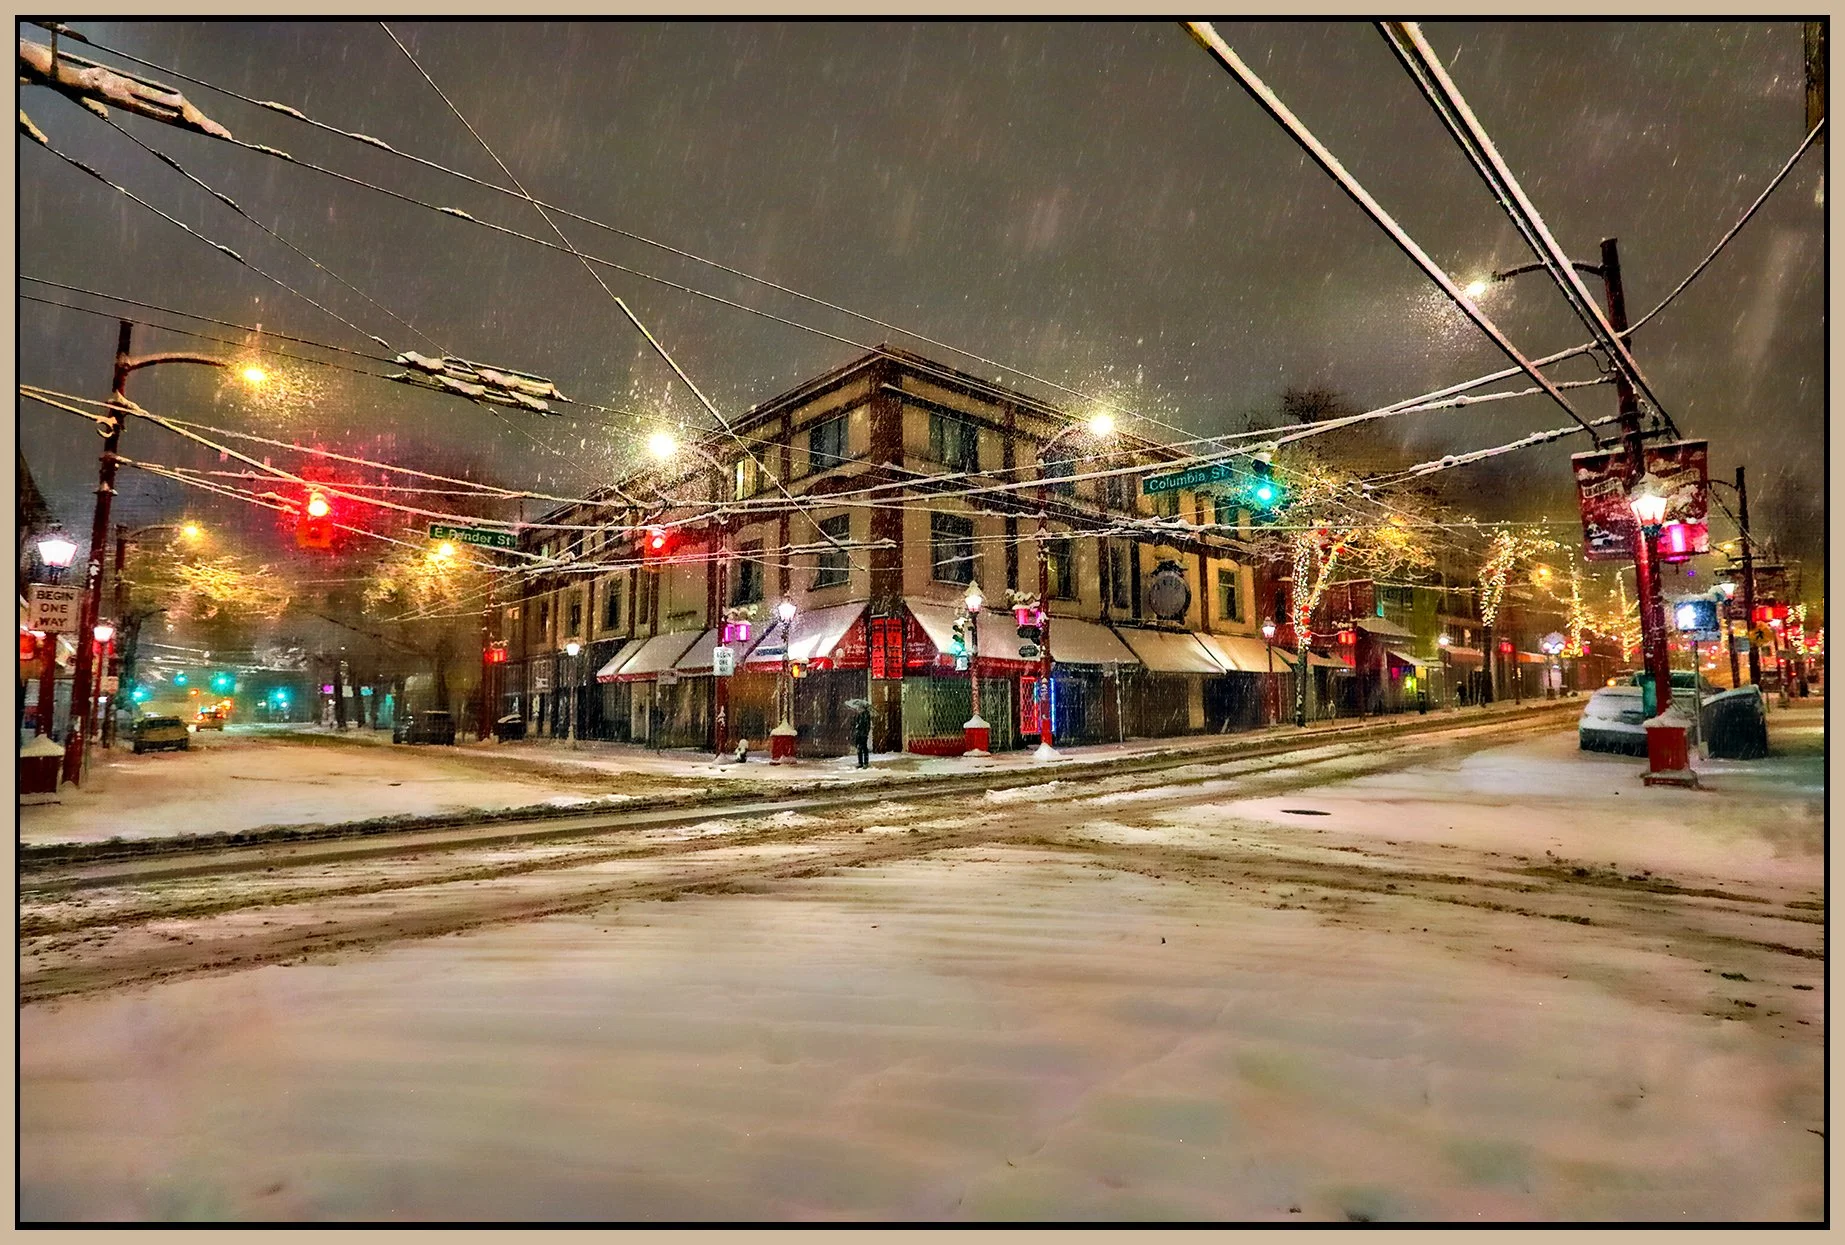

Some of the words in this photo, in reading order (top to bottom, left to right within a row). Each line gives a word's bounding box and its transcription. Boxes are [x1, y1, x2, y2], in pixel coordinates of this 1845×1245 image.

[1149, 472, 1206, 491] Columbia
[1211, 466, 1227, 479] St
[434, 527, 443, 538] E
[448, 529, 493, 544] Pender
[497, 535, 511, 546] St
[36, 590, 75, 601] BEGIN
[40, 603, 68, 613] ONE
[39, 617, 68, 627] WAY
